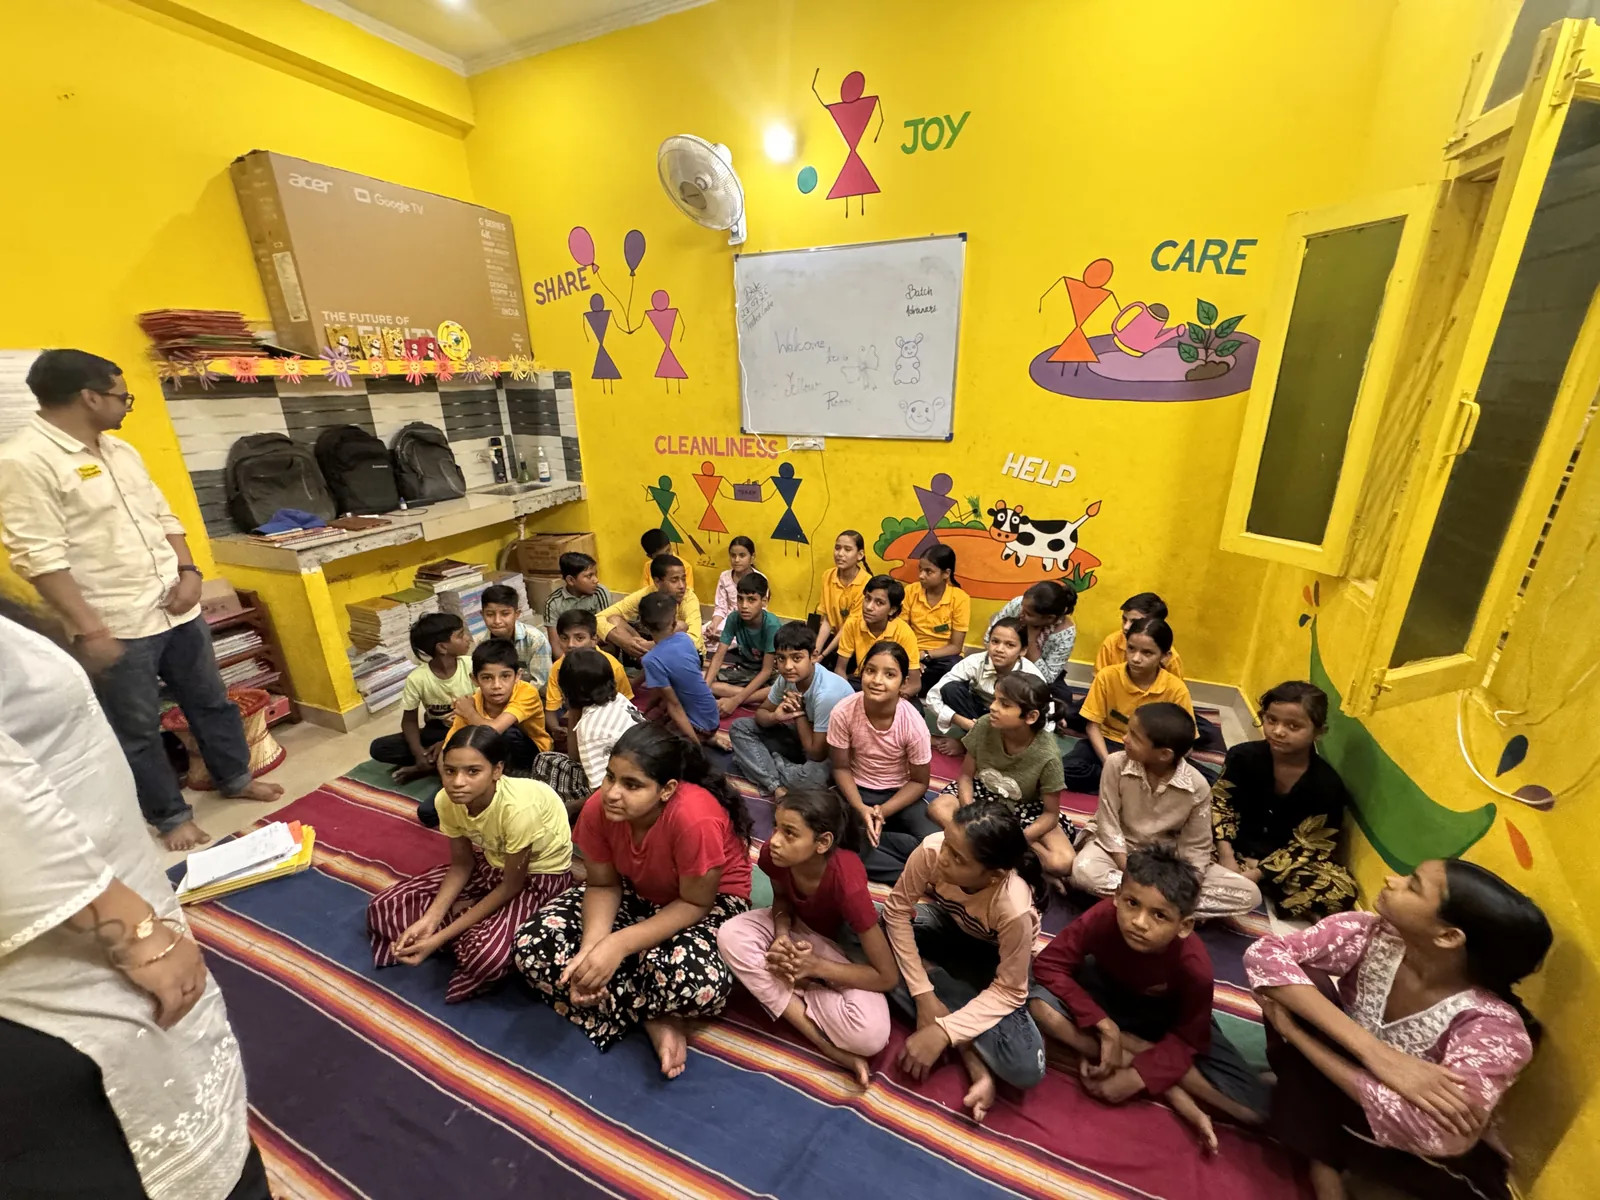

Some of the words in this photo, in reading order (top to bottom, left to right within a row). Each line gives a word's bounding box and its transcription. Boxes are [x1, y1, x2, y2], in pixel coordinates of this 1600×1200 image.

[900, 111, 971, 154] JOY
[288, 172, 333, 193] acer
[373, 193, 410, 213] Google
[411, 203, 424, 215] TV
[1150, 238, 1258, 275] CARE
[533, 266, 591, 305] SHARE
[905, 284, 933, 300] Batch
[321, 311, 347, 322] THE
[349, 313, 393, 325] FUTURE
[395, 316, 410, 325] OF
[774, 326, 825, 354] Welcome
[654, 435, 779, 459] CLEANLINESS
[1001, 452, 1077, 488] HELP
